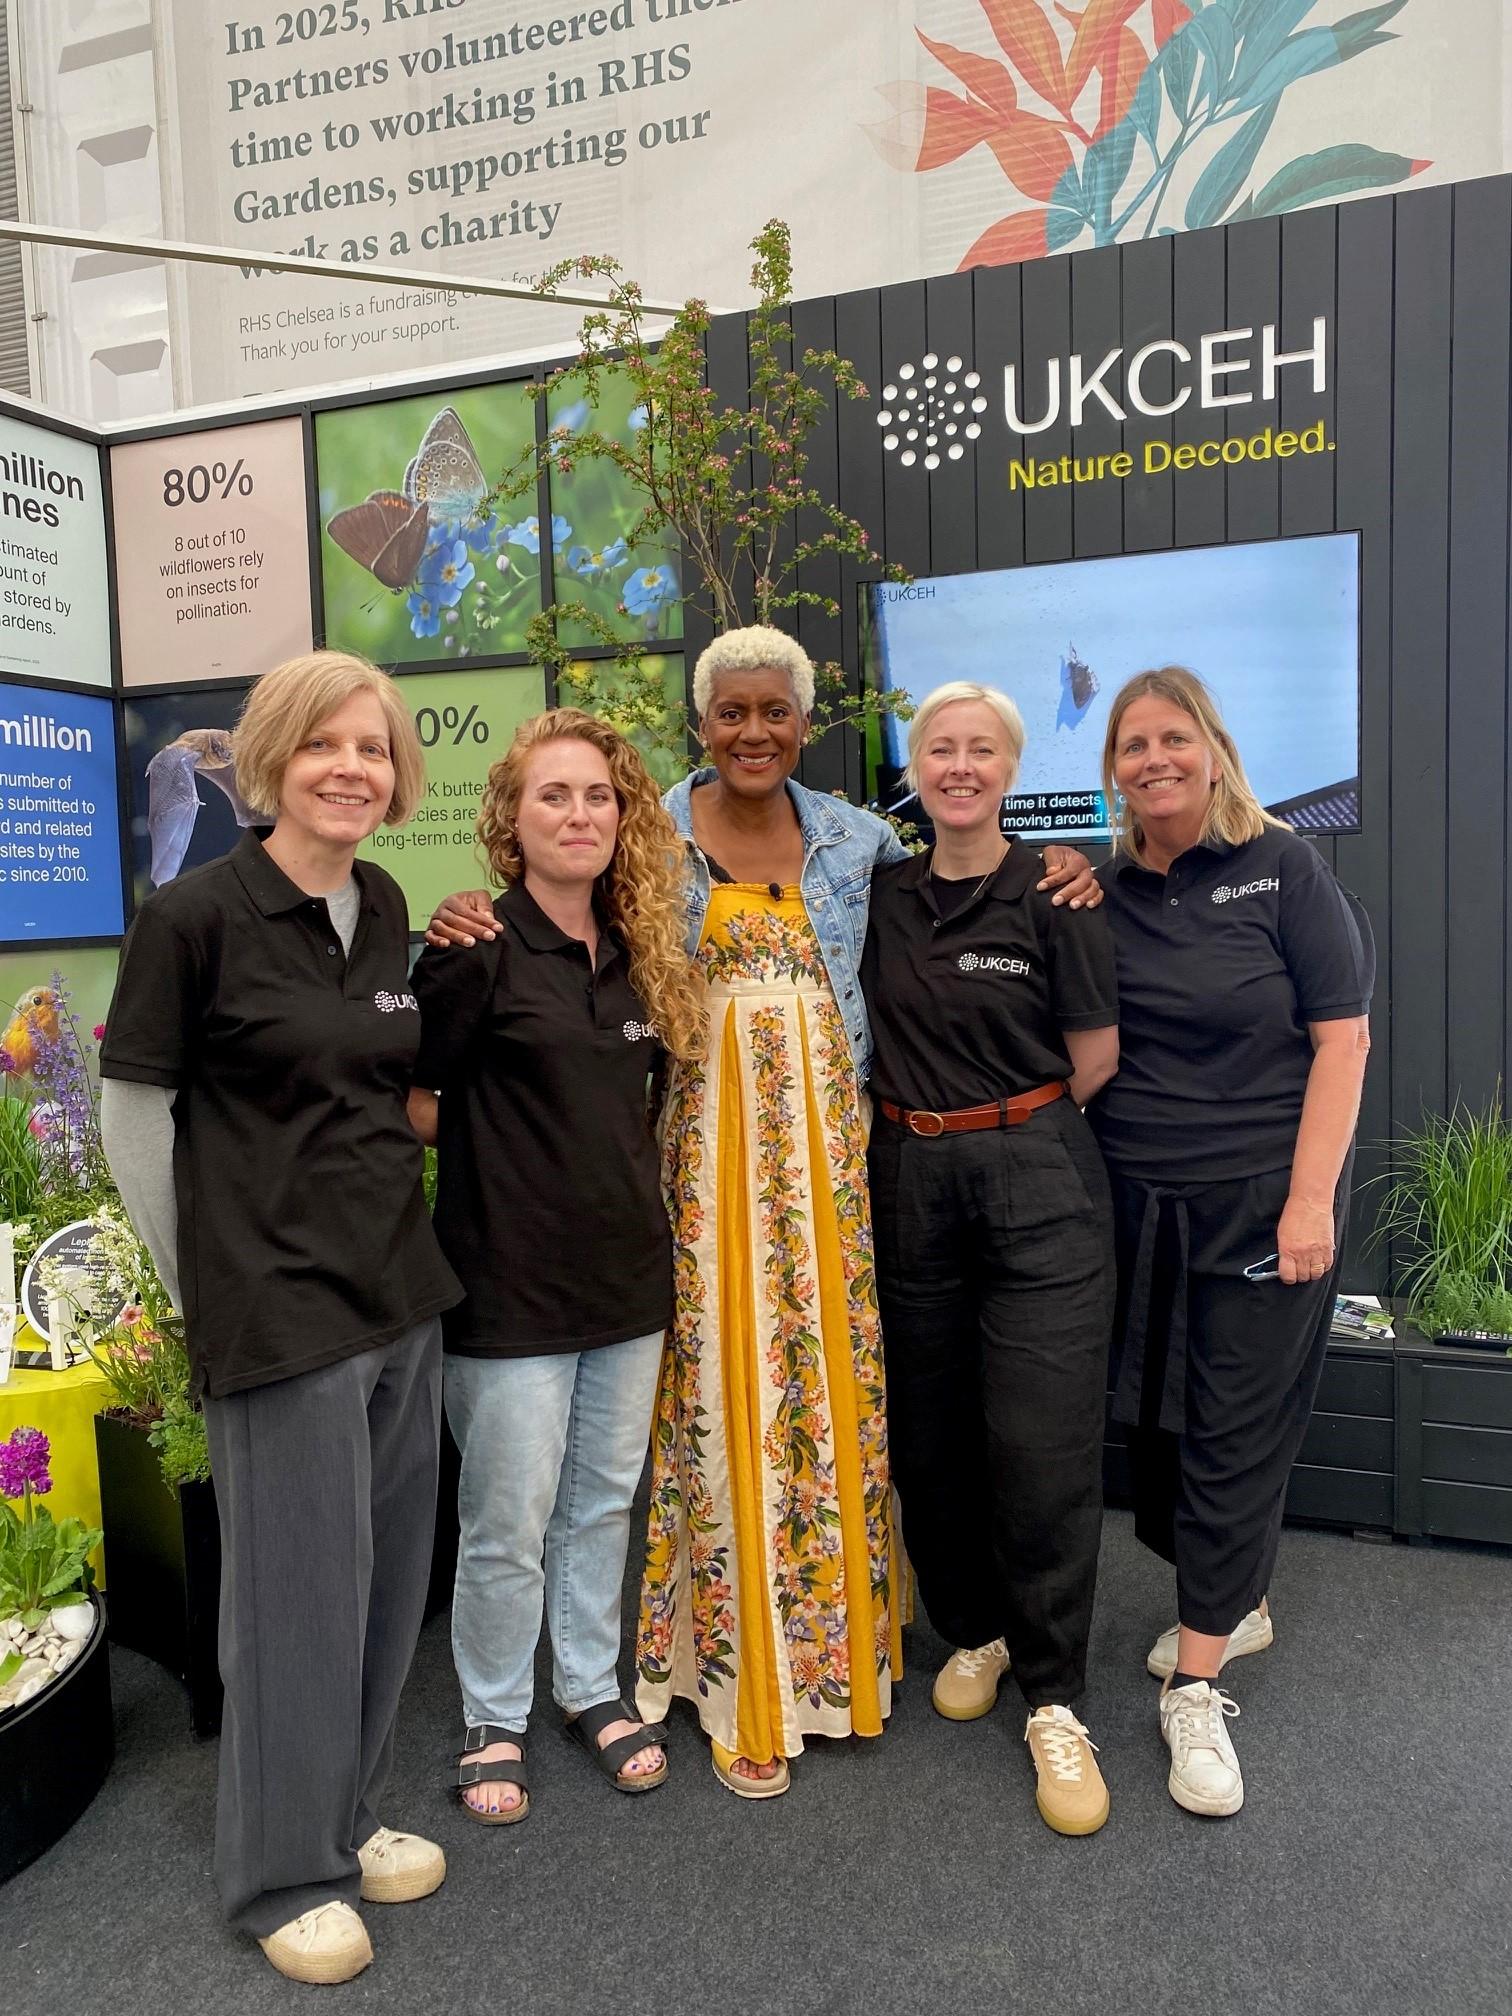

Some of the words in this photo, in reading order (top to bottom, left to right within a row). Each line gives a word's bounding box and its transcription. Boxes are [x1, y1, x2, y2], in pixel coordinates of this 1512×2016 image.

[225, 21, 266, 55] In
[275, 0, 370, 47] 2025,
[228, 56, 389, 112] Partners
[399, 0, 635, 78] volunteered
[230, 127, 312, 168] time
[322, 119, 360, 151] to
[370, 84, 536, 142] working
[545, 71, 587, 109] in
[599, 43, 692, 97] RHS
[233, 174, 397, 224] Gardens,
[407, 126, 627, 197] supporting
[638, 108, 711, 150] our
[340, 235, 379, 263] as
[389, 231, 411, 256] a
[420, 199, 563, 251] charity
[239, 313, 271, 335] RHS
[276, 306, 335, 328] Chelsea
[339, 302, 351, 319] is
[355, 302, 365, 317] a
[369, 289, 457, 314] fundraising
[240, 339, 287, 362] Thank
[290, 338, 319, 360] you
[323, 331, 347, 351] for
[351, 327, 388, 352] your
[392, 315, 460, 343] support.
[1004, 316, 1327, 435] UKCEH
[1009, 449, 1133, 491] Nature
[1144, 420, 1336, 474] Decoded.
[163, 458, 254, 507] 80%
[0, 539, 58, 565] timated
[174, 536, 184, 552] 8
[187, 534, 209, 551] out
[213, 530, 226, 547] of
[229, 528, 246, 545] 10
[159, 553, 235, 577] wildflowers
[239, 550, 264, 569] rely
[32, 571, 46, 586] of
[166, 584, 184, 599] on
[187, 578, 237, 597] insects
[240, 575, 260, 591] for
[4, 590, 51, 611] stored
[55, 597, 71, 618] by
[888, 586, 936, 602] UKCEH
[176, 600, 252, 624] pollination.
[0, 614, 56, 635] ardens.
[0, 772, 55, 789] number
[58, 775, 72, 790] of
[7, 796, 79, 814] submitted
[82, 800, 95, 815] to
[1005, 798, 1035, 810] time
[1038, 796, 1047, 809] it
[1049, 793, 1102, 808] detects
[409, 806, 448, 823] cies
[453, 807, 478, 821] are
[1003, 813, 1052, 828] moving
[1055, 812, 1103, 825] around
[14, 819, 41, 835] and
[45, 821, 92, 837] related
[38, 842, 55, 862] by
[57, 844, 80, 859] the
[372, 831, 448, 850] long-term
[10, 866, 50, 882] since
[53, 866, 89, 882] 2010.
[1232, 878, 1280, 900] UKCEH
[980, 955, 1030, 976] UKCEH
